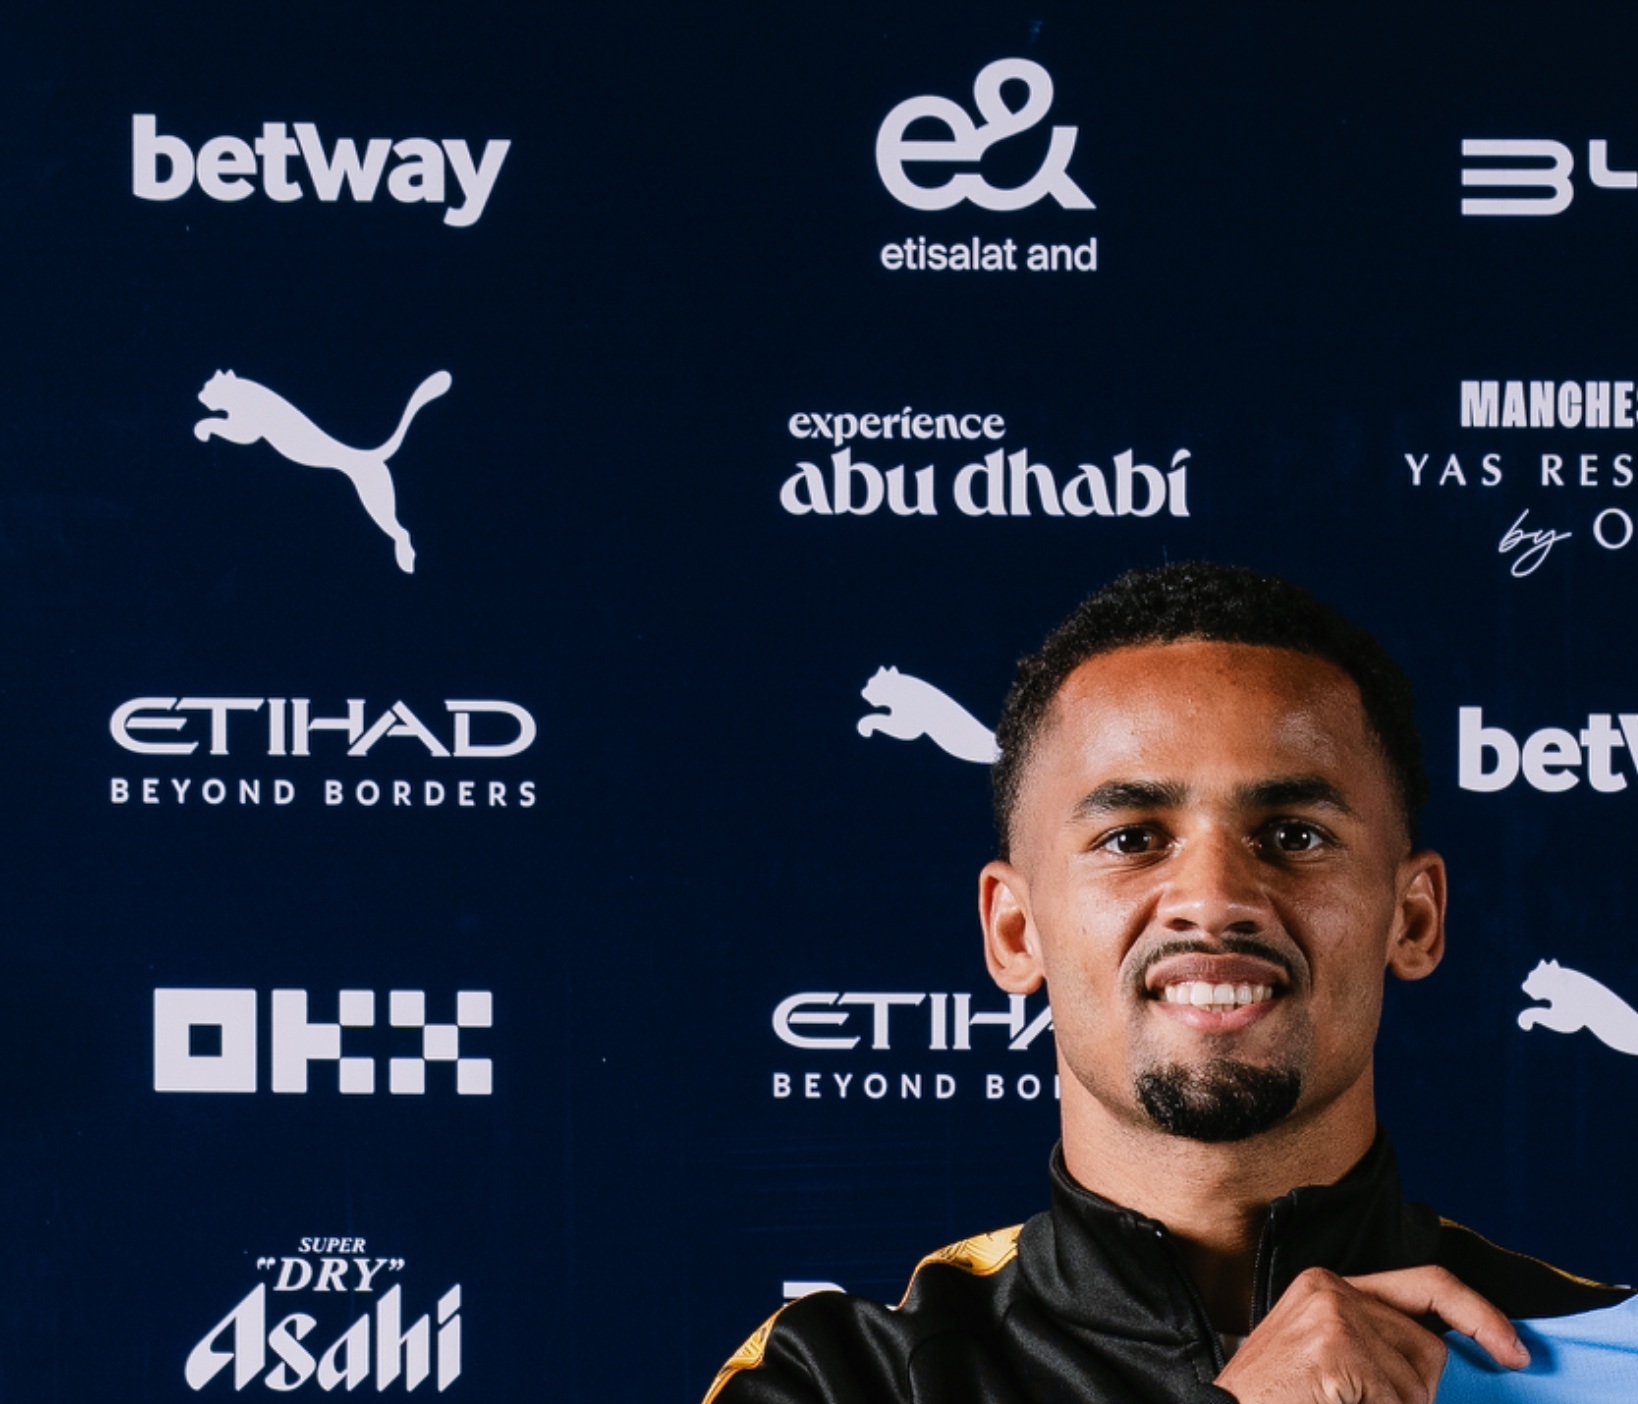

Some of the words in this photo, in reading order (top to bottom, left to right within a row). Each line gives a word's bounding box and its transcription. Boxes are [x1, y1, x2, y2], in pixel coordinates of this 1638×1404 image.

[131, 113, 512, 227] betway
[879, 235, 1018, 272] etisalat
[1026, 236, 1098, 272] and
[779, 446, 939, 517] abu
[1404, 452, 1503, 487] YAS
[1497, 508, 1573, 578] by
[108, 696, 537, 758] ETIHAD
[110, 777, 296, 805] BEYOND
[324, 779, 536, 808] BORDERS
[152, 987, 494, 1096] OKX
[771, 991, 1055, 1050] ETIH
[772, 1072, 956, 1100] BEYOND
[297, 1236, 367, 1254] SUPER
[183, 1281, 462, 1393] Asahi
